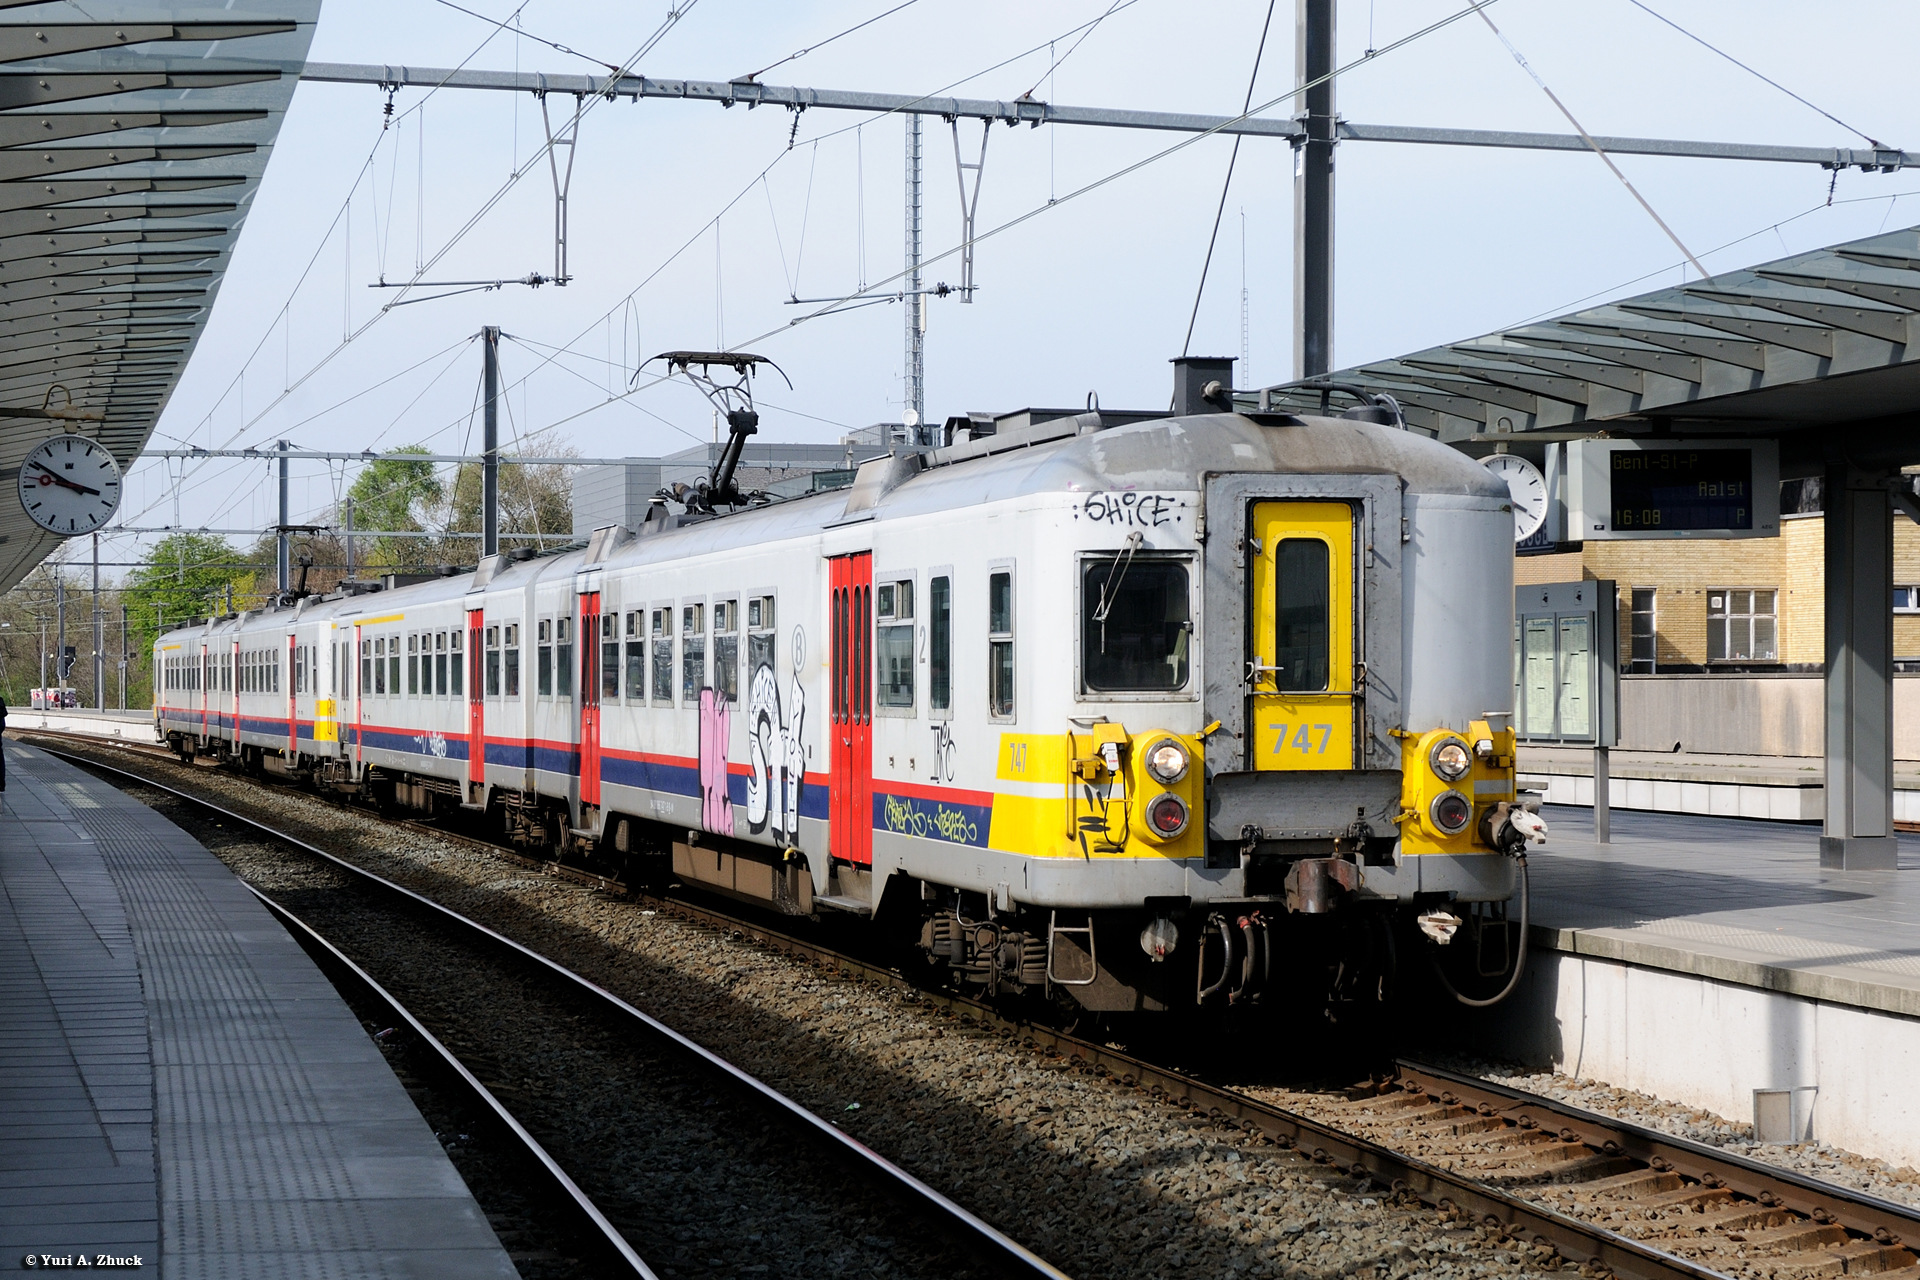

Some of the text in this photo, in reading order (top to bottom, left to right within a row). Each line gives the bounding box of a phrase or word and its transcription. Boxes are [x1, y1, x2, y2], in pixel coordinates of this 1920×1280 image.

[1613, 454, 1698, 470] Gent-St-P
[1698, 481, 1744, 497] Aalst
[1615, 508, 1745, 525] 16:08 P
[741, 636, 746, 667] 2
[919, 625, 926, 664] 2
[1269, 724, 1333, 754] 747
[1009, 742, 1027, 773] 747
